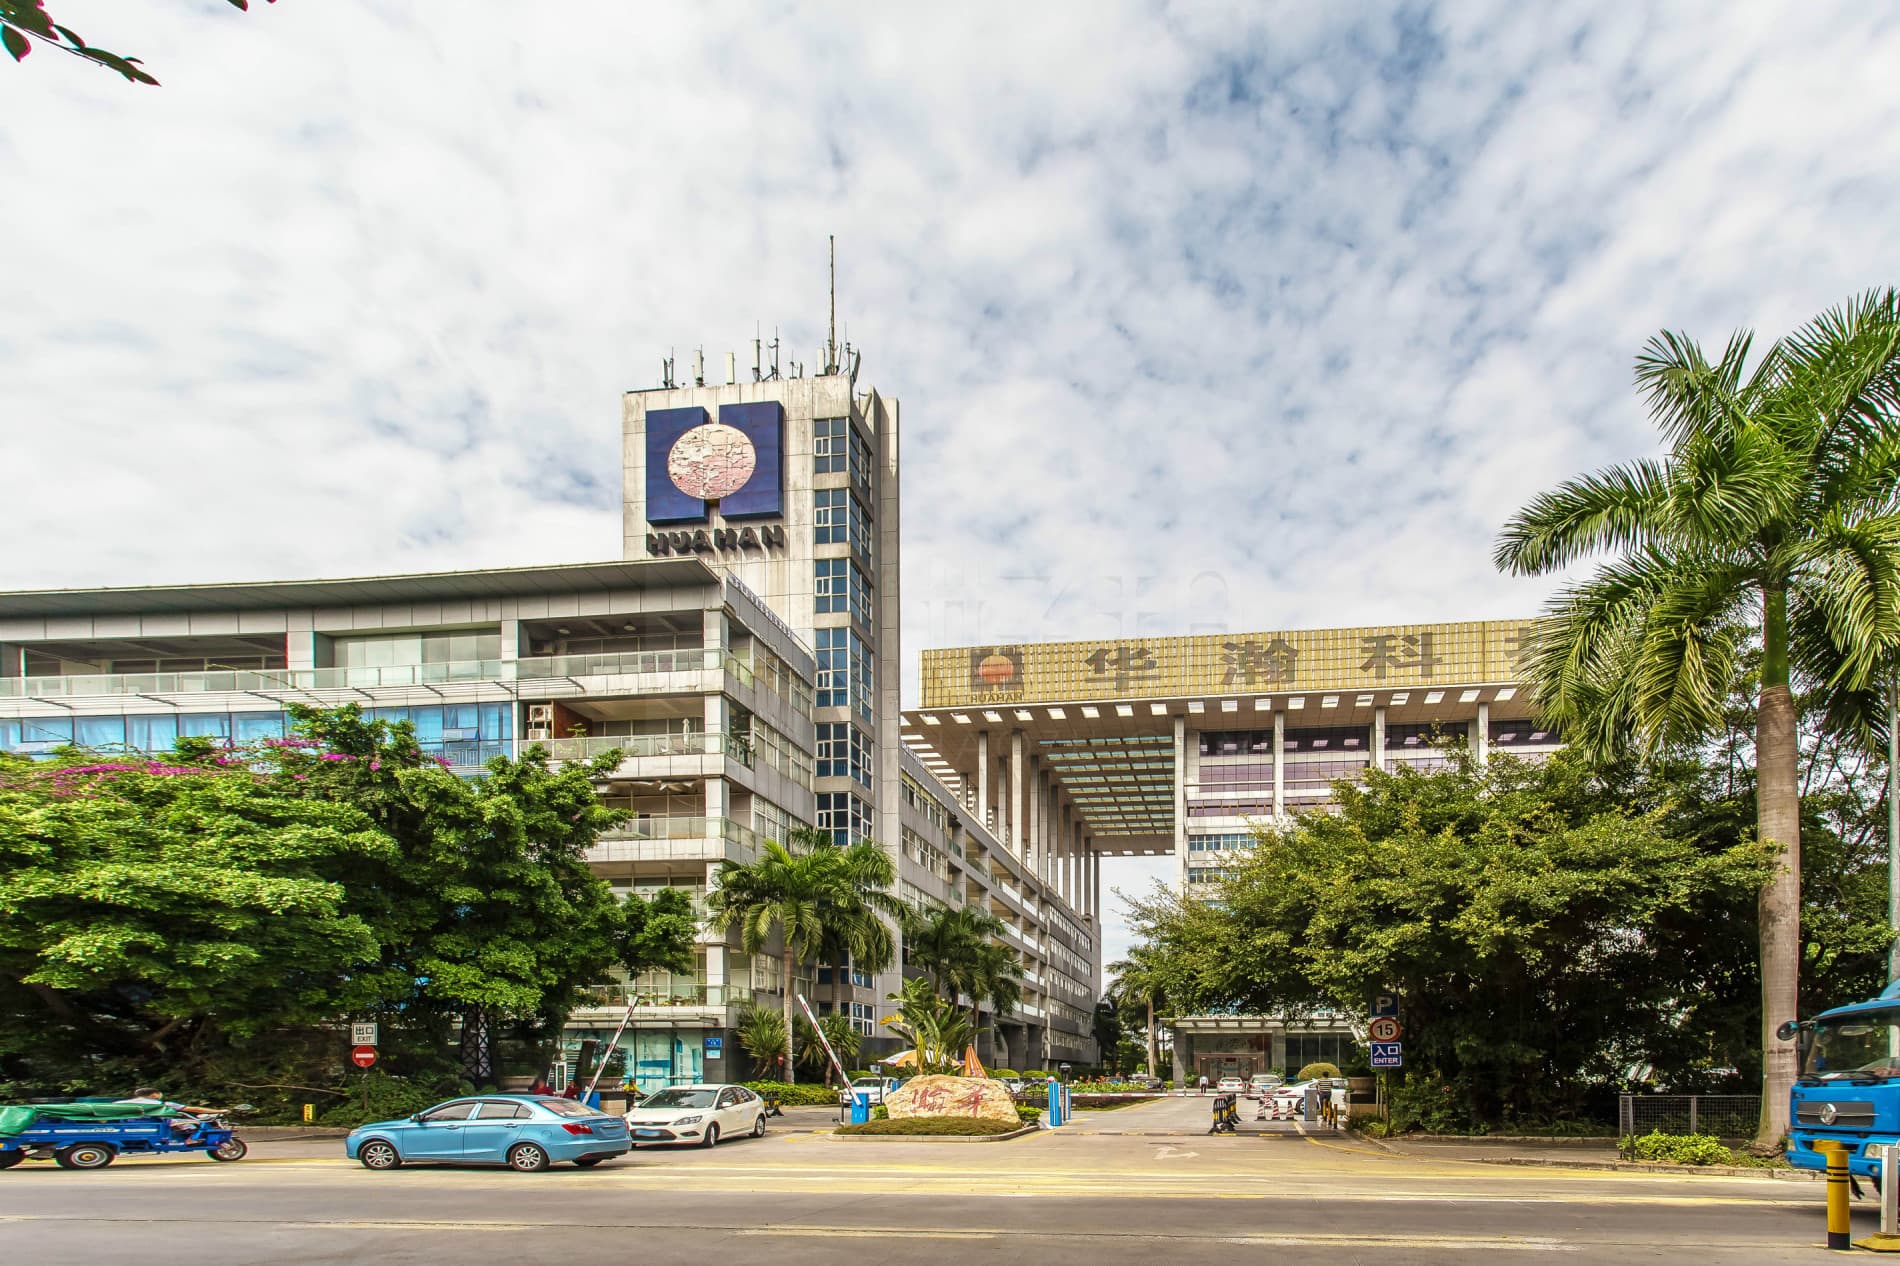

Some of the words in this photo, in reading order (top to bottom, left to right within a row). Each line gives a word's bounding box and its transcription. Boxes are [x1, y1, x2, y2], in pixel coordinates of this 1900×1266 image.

[646, 525, 785, 556] HUAHAN
[970, 690, 1023, 703] HUAHAN
[1376, 996, 1392, 1013] P
[355, 1026, 374, 1036] 出口
[1377, 1023, 1393, 1036] 15
[1374, 1045, 1399, 1057] 入口
